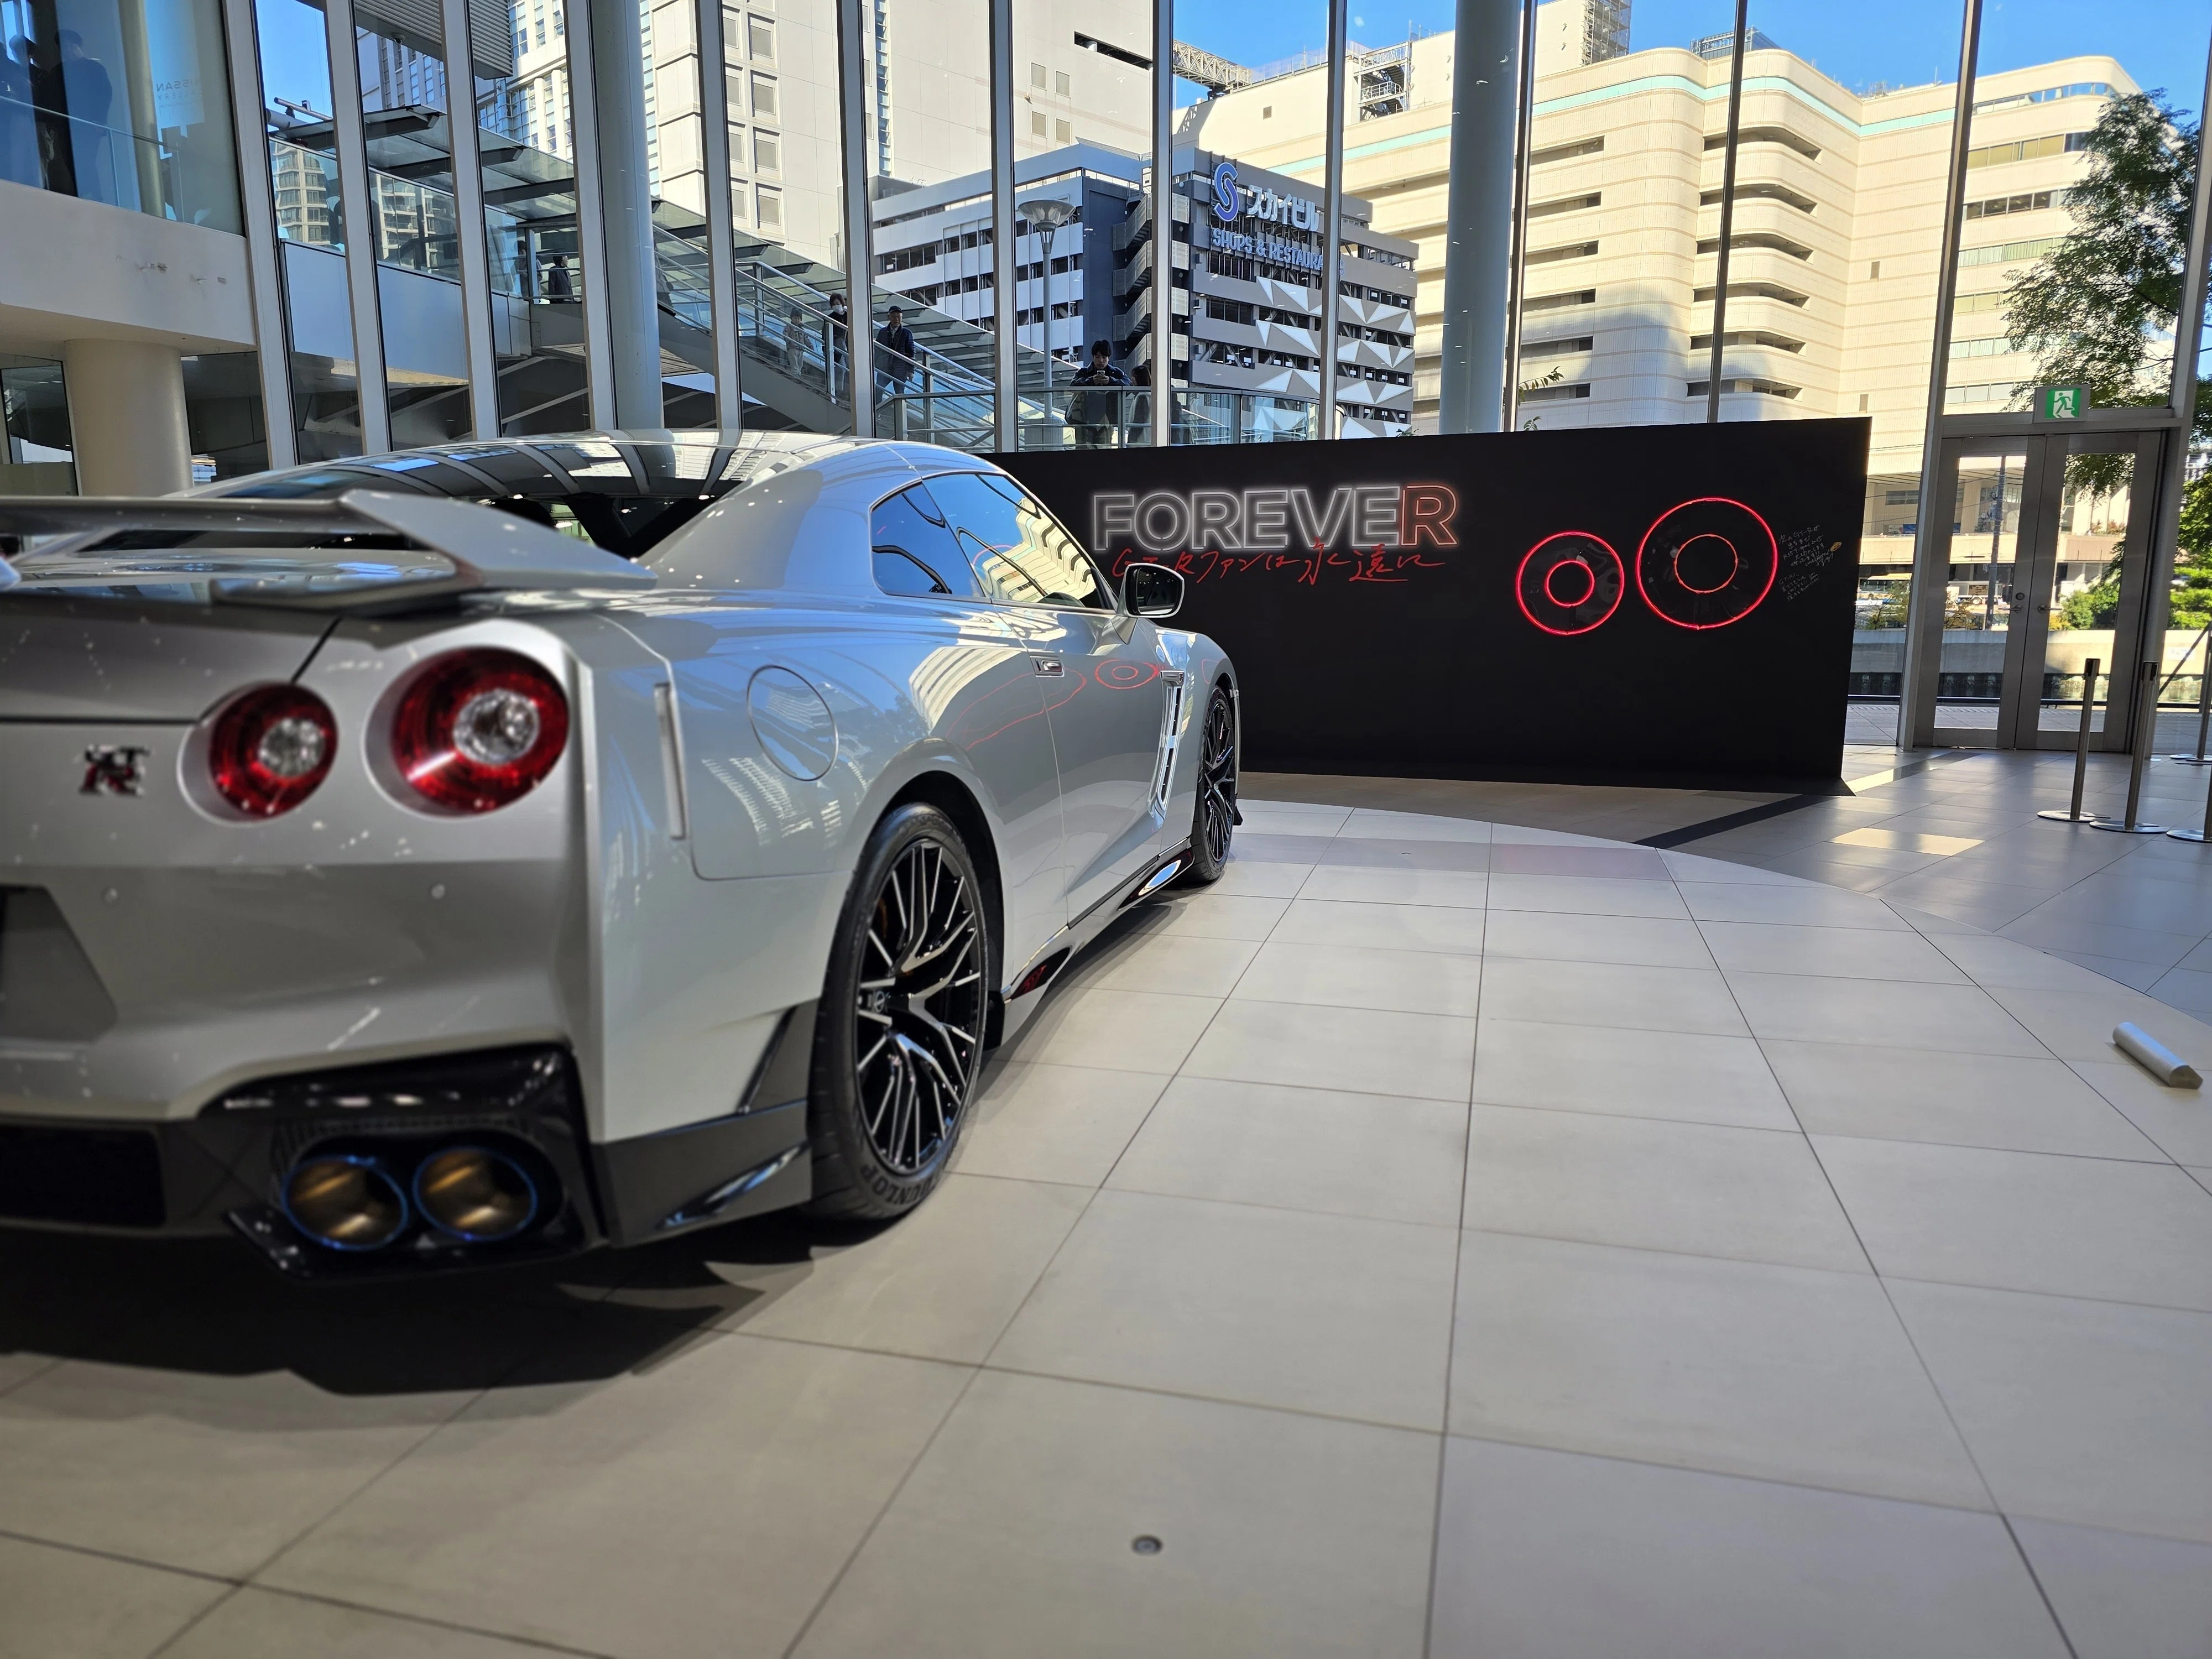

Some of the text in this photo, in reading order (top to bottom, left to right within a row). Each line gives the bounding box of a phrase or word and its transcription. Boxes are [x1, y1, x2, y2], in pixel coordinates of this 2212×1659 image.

[1248, 184, 1319, 231] スカイビル
[1213, 228, 1344, 275] SHOPS & RESTAURAS
[1094, 485, 1457, 551] FOREVER
